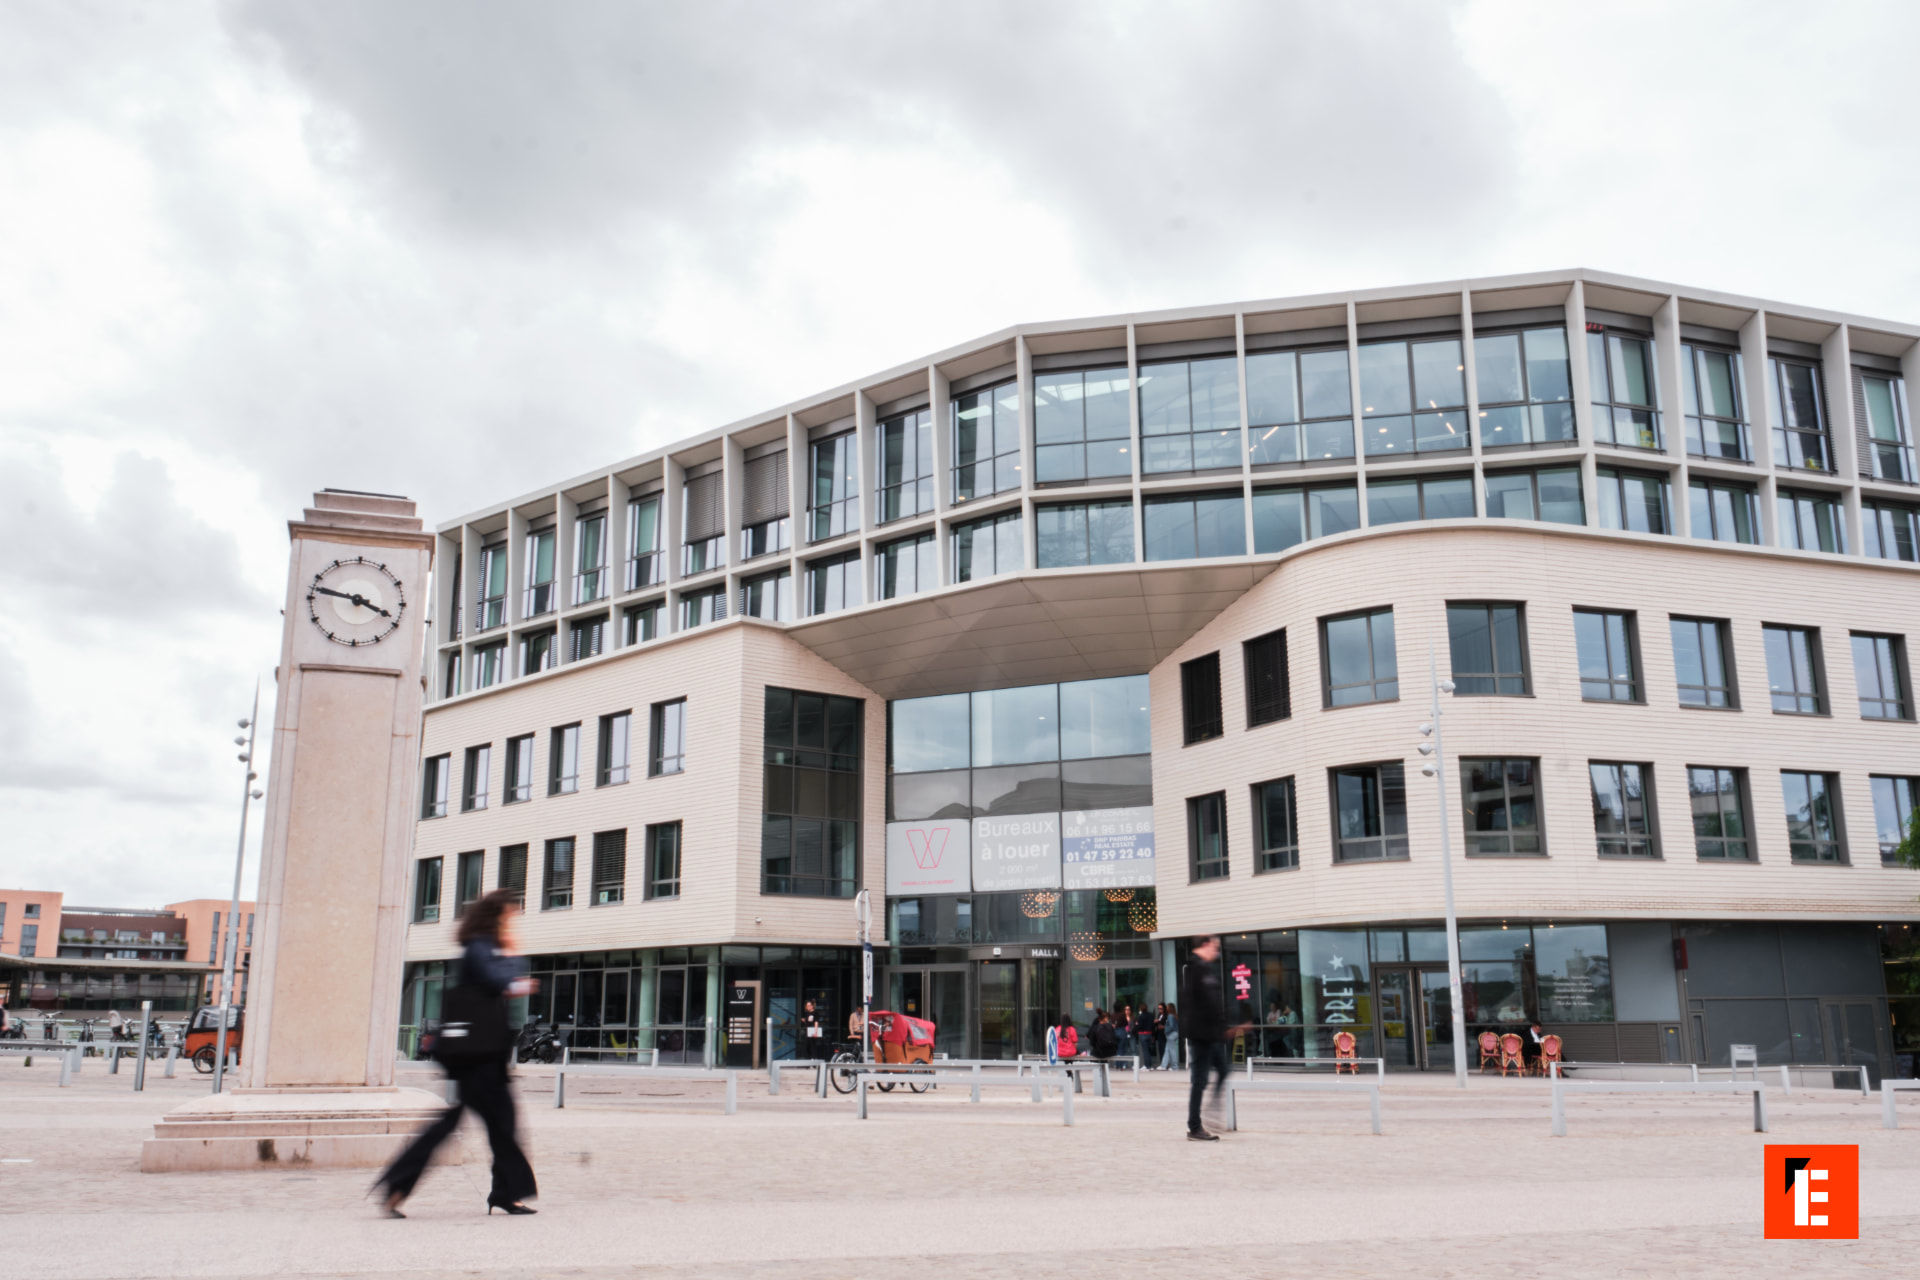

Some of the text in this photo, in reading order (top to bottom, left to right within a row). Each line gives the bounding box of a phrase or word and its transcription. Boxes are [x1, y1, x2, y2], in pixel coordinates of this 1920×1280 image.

[978, 820, 1055, 838] Bureaux
[1120, 823, 1133, 833] 15
[1136, 821, 1151, 832] 66
[981, 842, 1050, 860] à louer
[1112, 841, 1135, 849] ESTATE
[1066, 847, 1152, 862] 01 47 59 22 40
[1080, 864, 1115, 876] CBRE
[1068, 879, 1081, 889] 01
[1031, 948, 1058, 957] HALL A
[1322, 974, 1355, 1023] PRET
